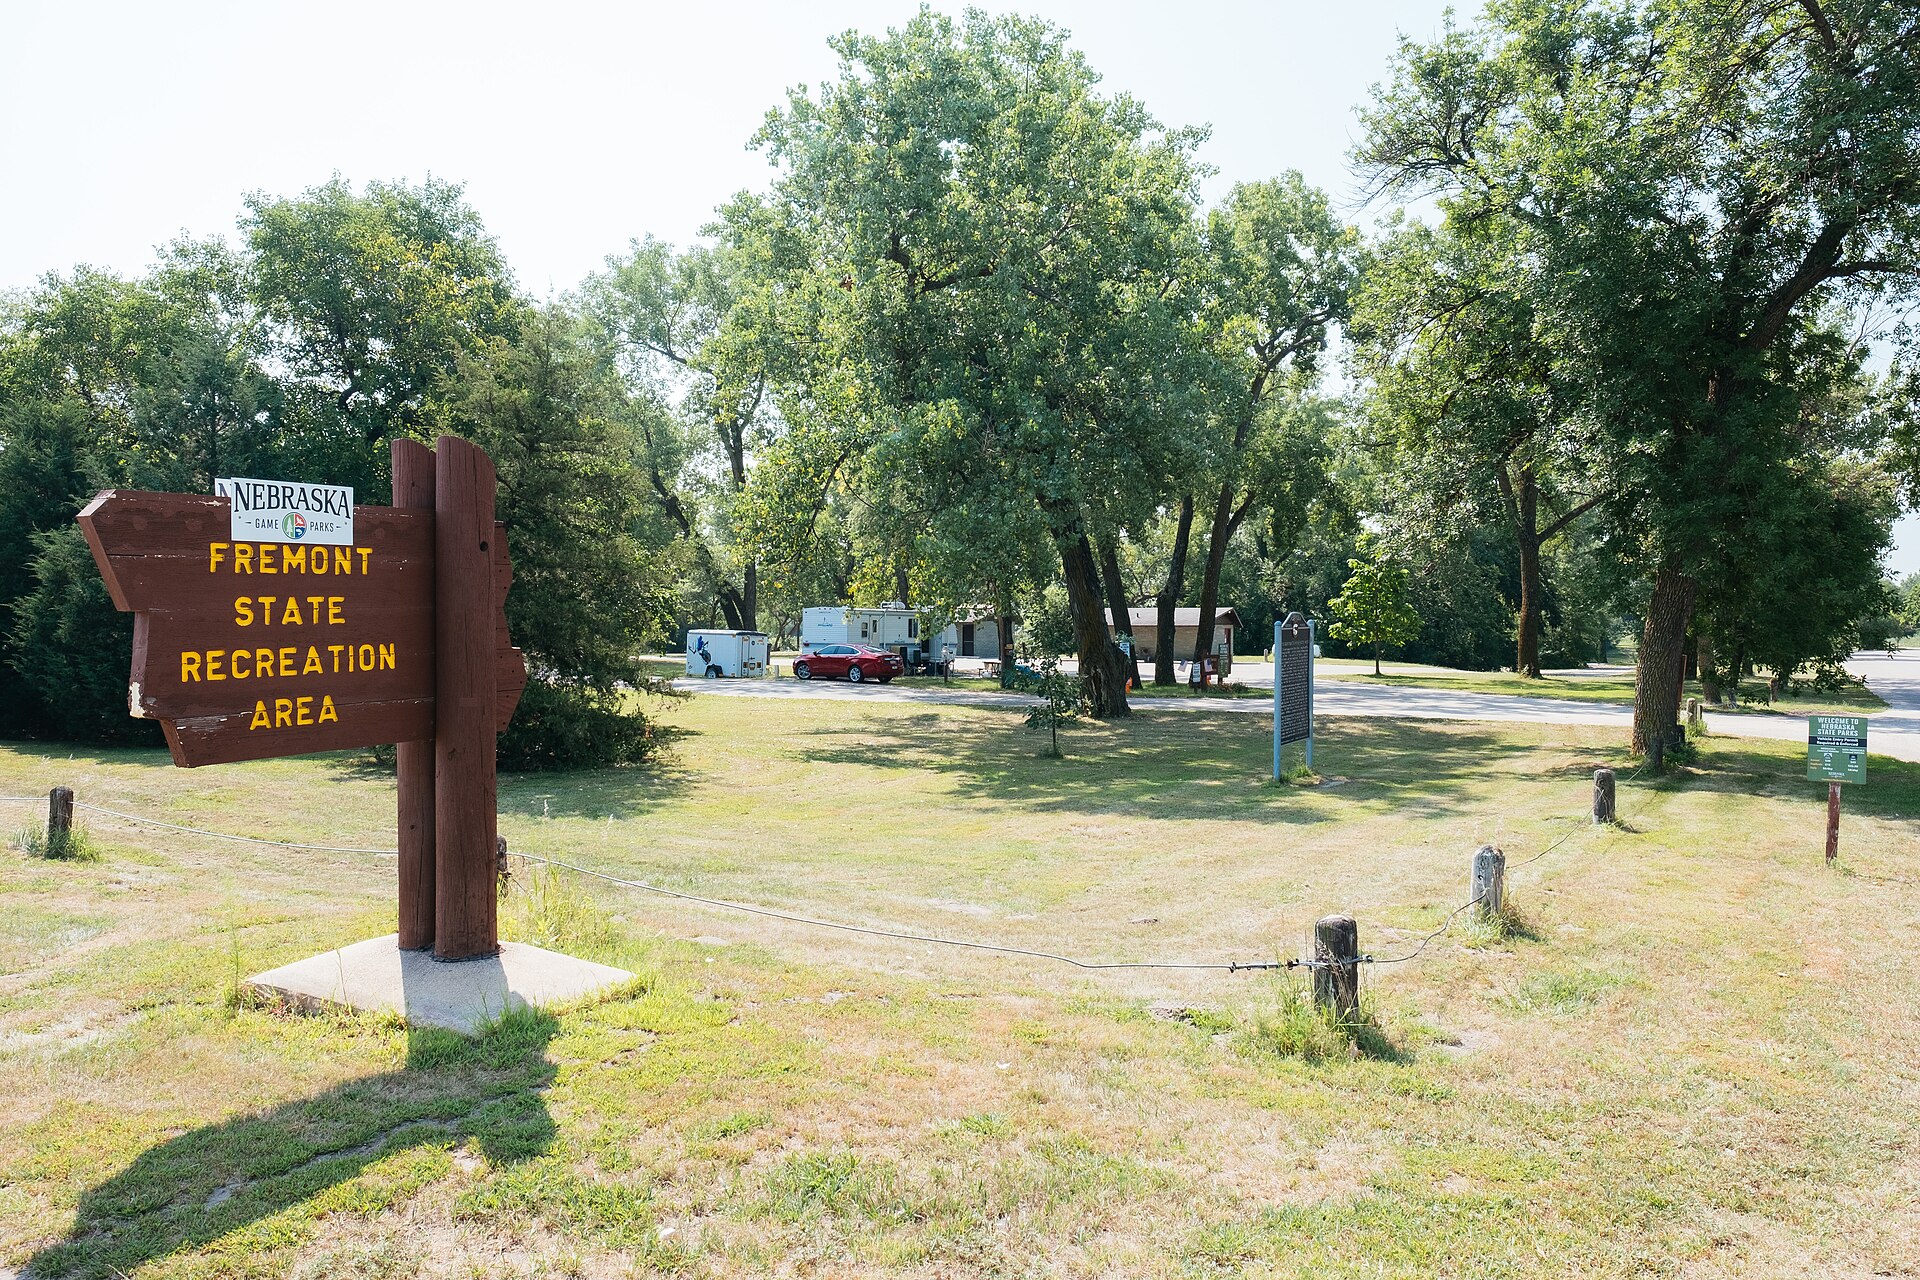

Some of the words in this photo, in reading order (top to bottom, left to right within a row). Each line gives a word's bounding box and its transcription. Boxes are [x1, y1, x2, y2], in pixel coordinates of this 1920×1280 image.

[234, 482, 351, 519] NEBRASKA
[255, 519, 279, 530] GAME
[310, 521, 334, 532] PARKS
[209, 542, 373, 576] FREMONT
[234, 596, 346, 627] STATE
[181, 643, 396, 683] RECREATION
[249, 694, 338, 731] AREA
